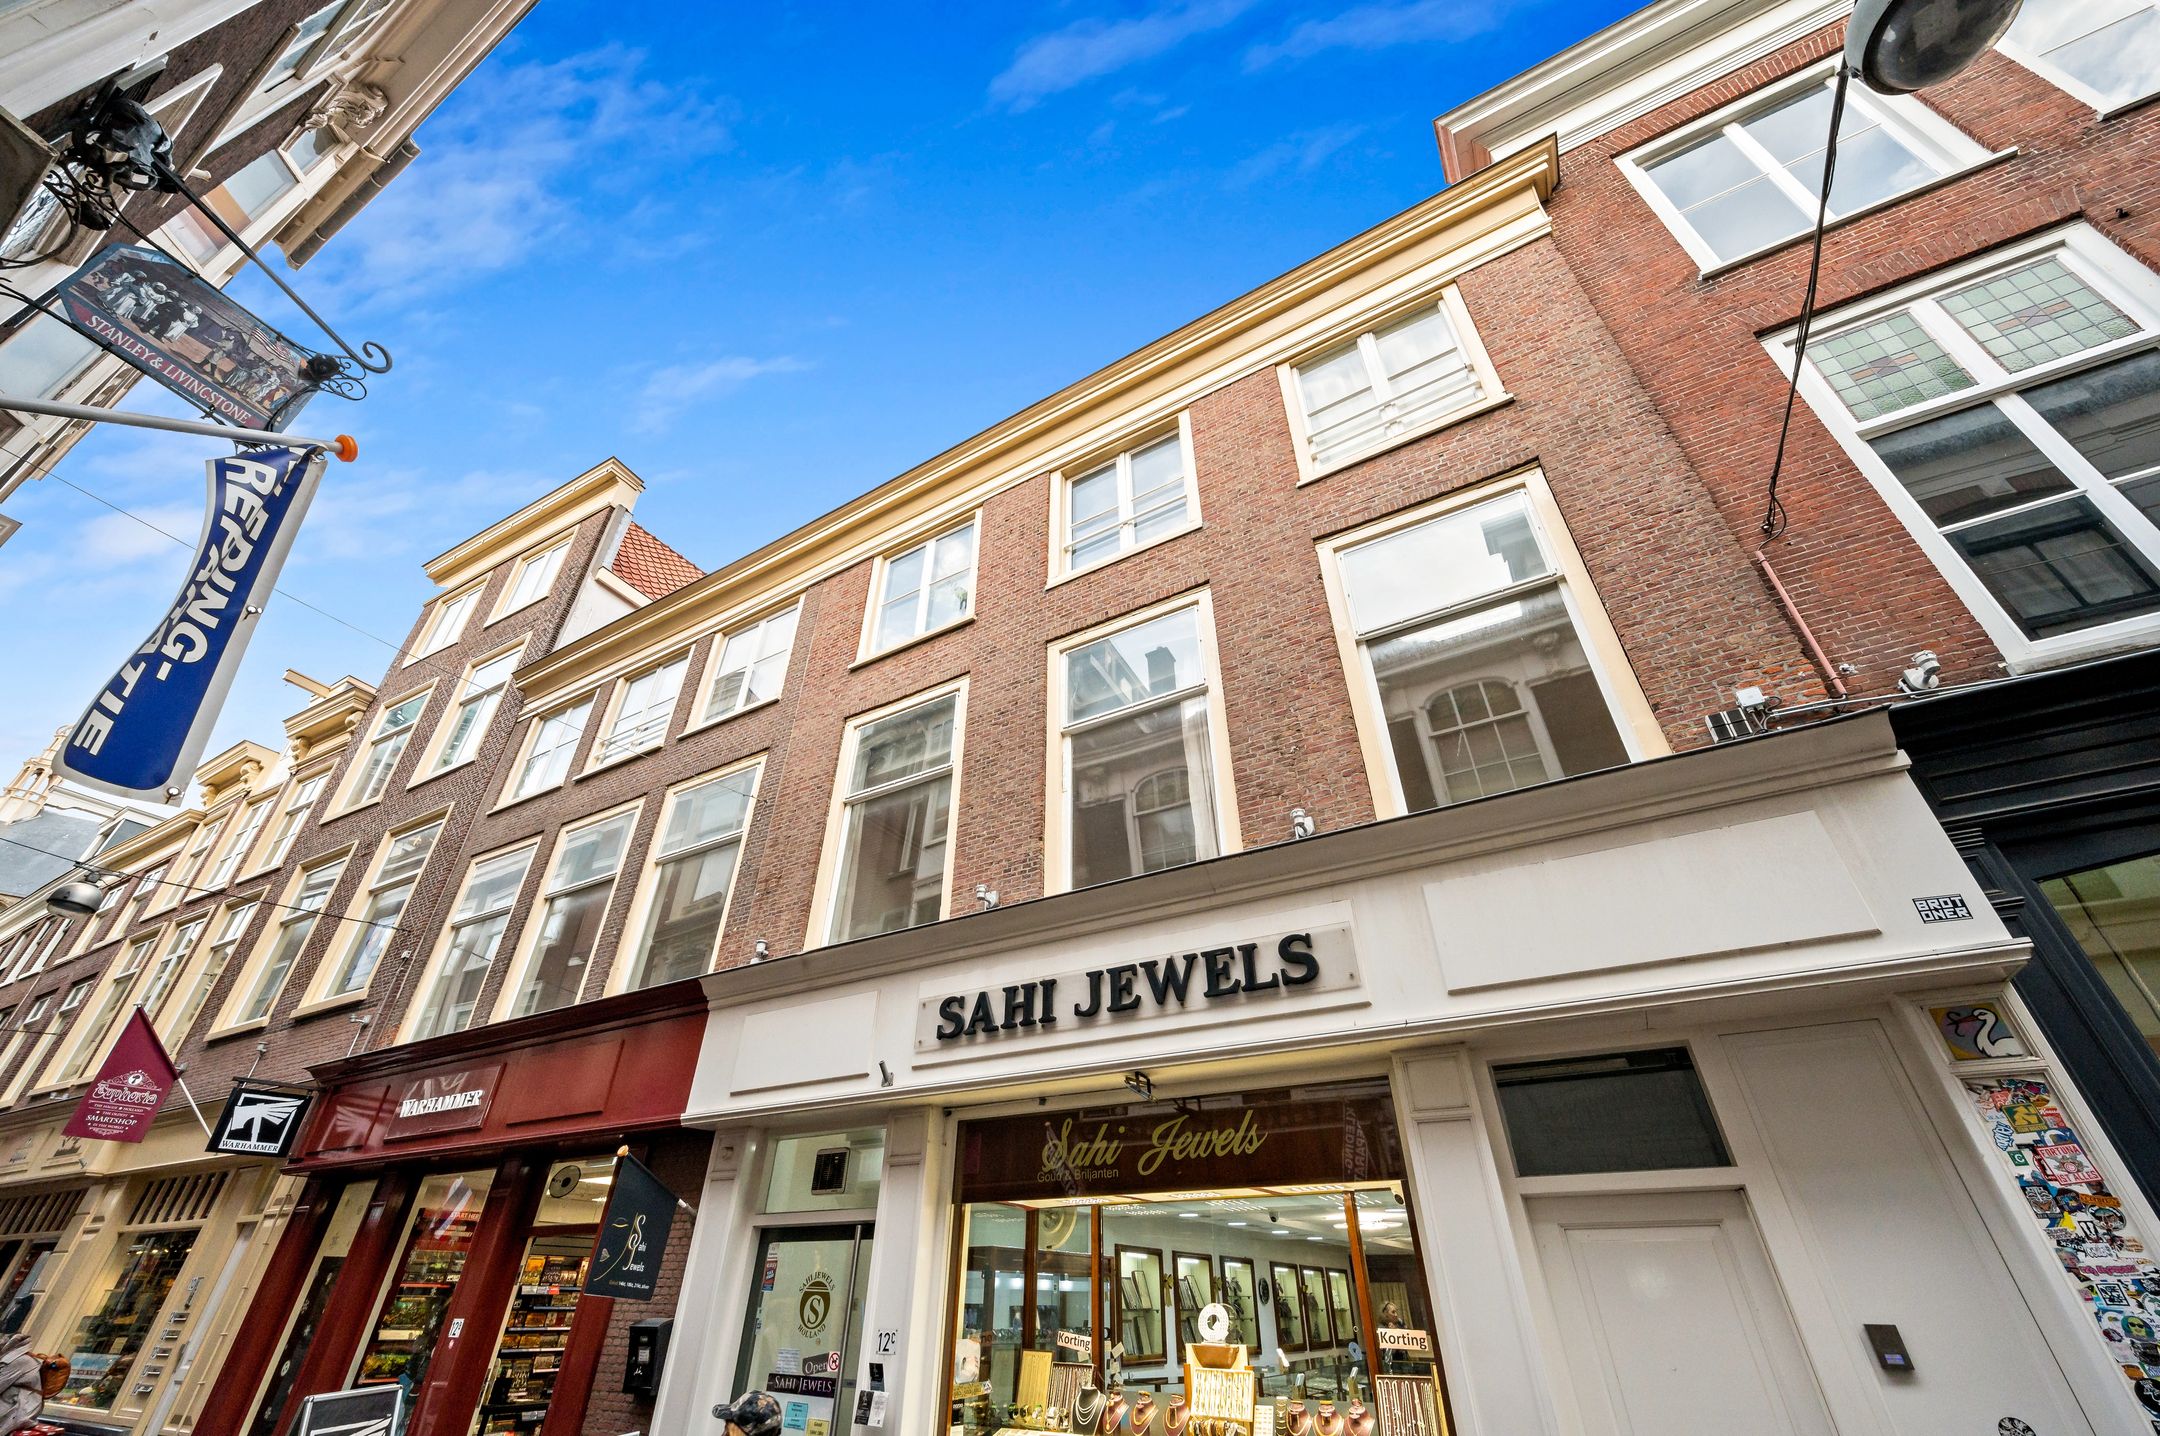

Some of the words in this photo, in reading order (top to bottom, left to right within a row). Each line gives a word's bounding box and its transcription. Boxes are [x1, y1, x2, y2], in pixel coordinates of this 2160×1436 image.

[85, 315, 151, 361] STANLEY
[150, 357, 163, 370] &
[163, 364, 252, 424] LIVINGSTONE
[1915, 896, 1962, 910] BROT
[1920, 907, 1970, 920] ONER
[936, 978, 1057, 1041] SAHI
[1073, 932, 1319, 1019] JEWELS
[92, 1080, 158, 1105] Euphoria
[400, 1090, 483, 1118] WARHAMMER
[86, 1114, 138, 1126] SMARTSHOP
[221, 1140, 279, 1152] WARHAMMER
[1041, 1117, 1126, 1173] Sahi
[1137, 1109, 1269, 1176] Jewels
[2040, 1145, 2081, 1157] FORTUNA
[1037, 1171, 1063, 1183] Goud
[1064, 1169, 1072, 1180] &
[1074, 1168, 1119, 1181] Briljanten
[2058, 1174, 2072, 1183] IST
[2073, 1171, 2099, 1181] ALLES
[799, 1274, 813, 1293] SAHI
[813, 1271, 836, 1291] JEWELS
[797, 1324, 827, 1338] HOLLAND
[1058, 1332, 1091, 1352] Korting
[1380, 1332, 1427, 1350] Korting
[805, 1361, 828, 1374] Open
[775, 1376, 796, 1389] SAHI
[798, 1377, 833, 1393] JEWELS
